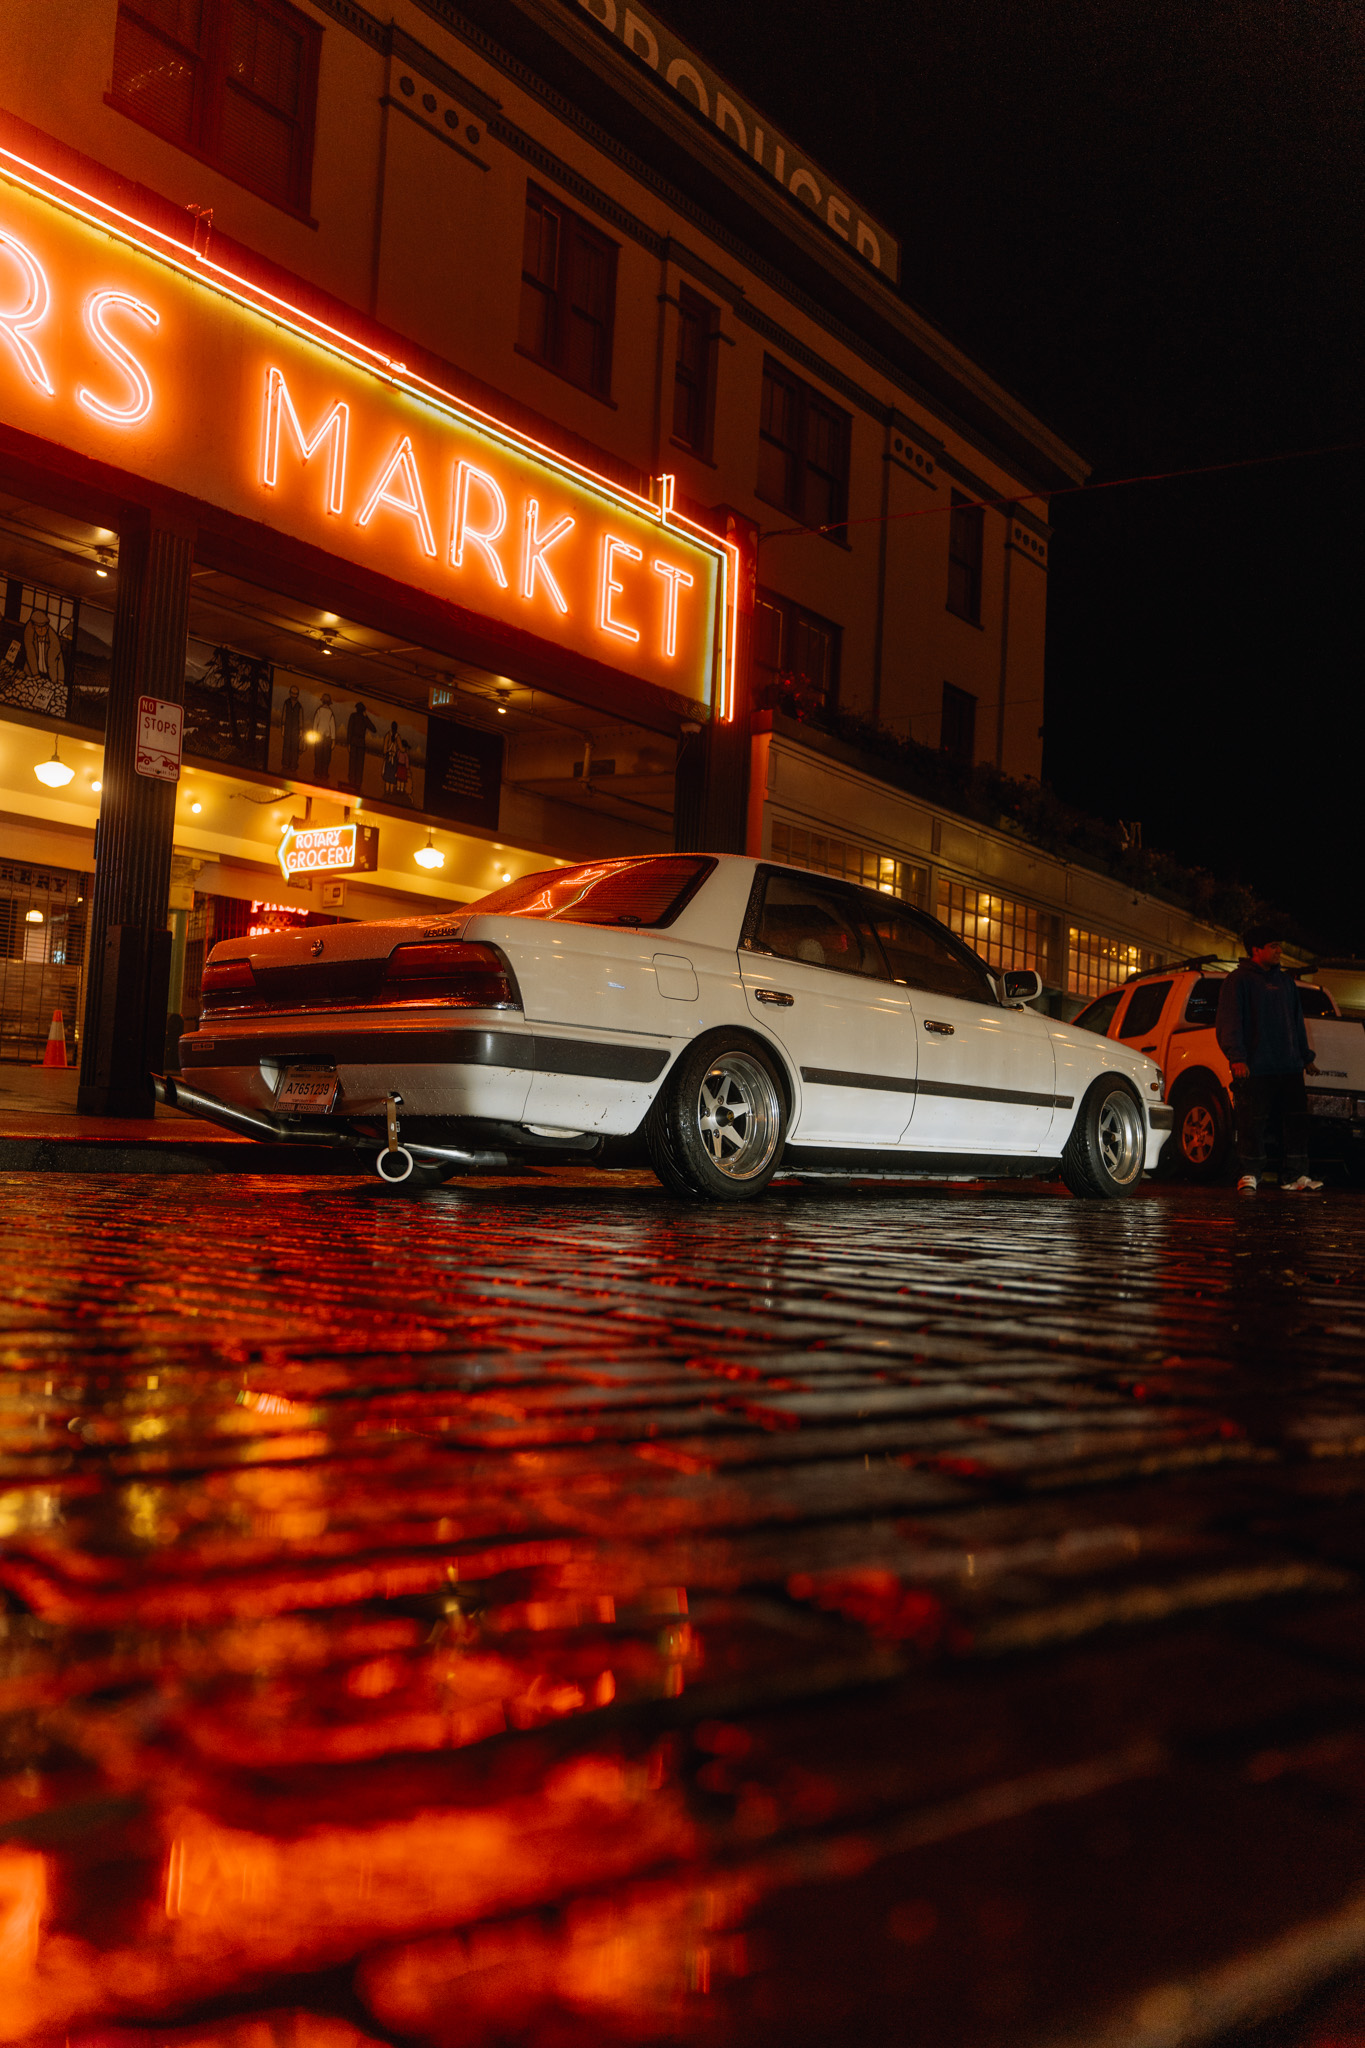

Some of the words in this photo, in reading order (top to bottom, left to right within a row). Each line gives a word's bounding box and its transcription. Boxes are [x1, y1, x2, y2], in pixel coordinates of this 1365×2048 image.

[262, 366, 694, 658] MARKET
[142, 700, 154, 713] NO
[144, 716, 177, 736] STOPS
[295, 829, 343, 849] ROTARY
[286, 845, 354, 870] GROCERY
[285, 1082, 330, 1096] A7651239
